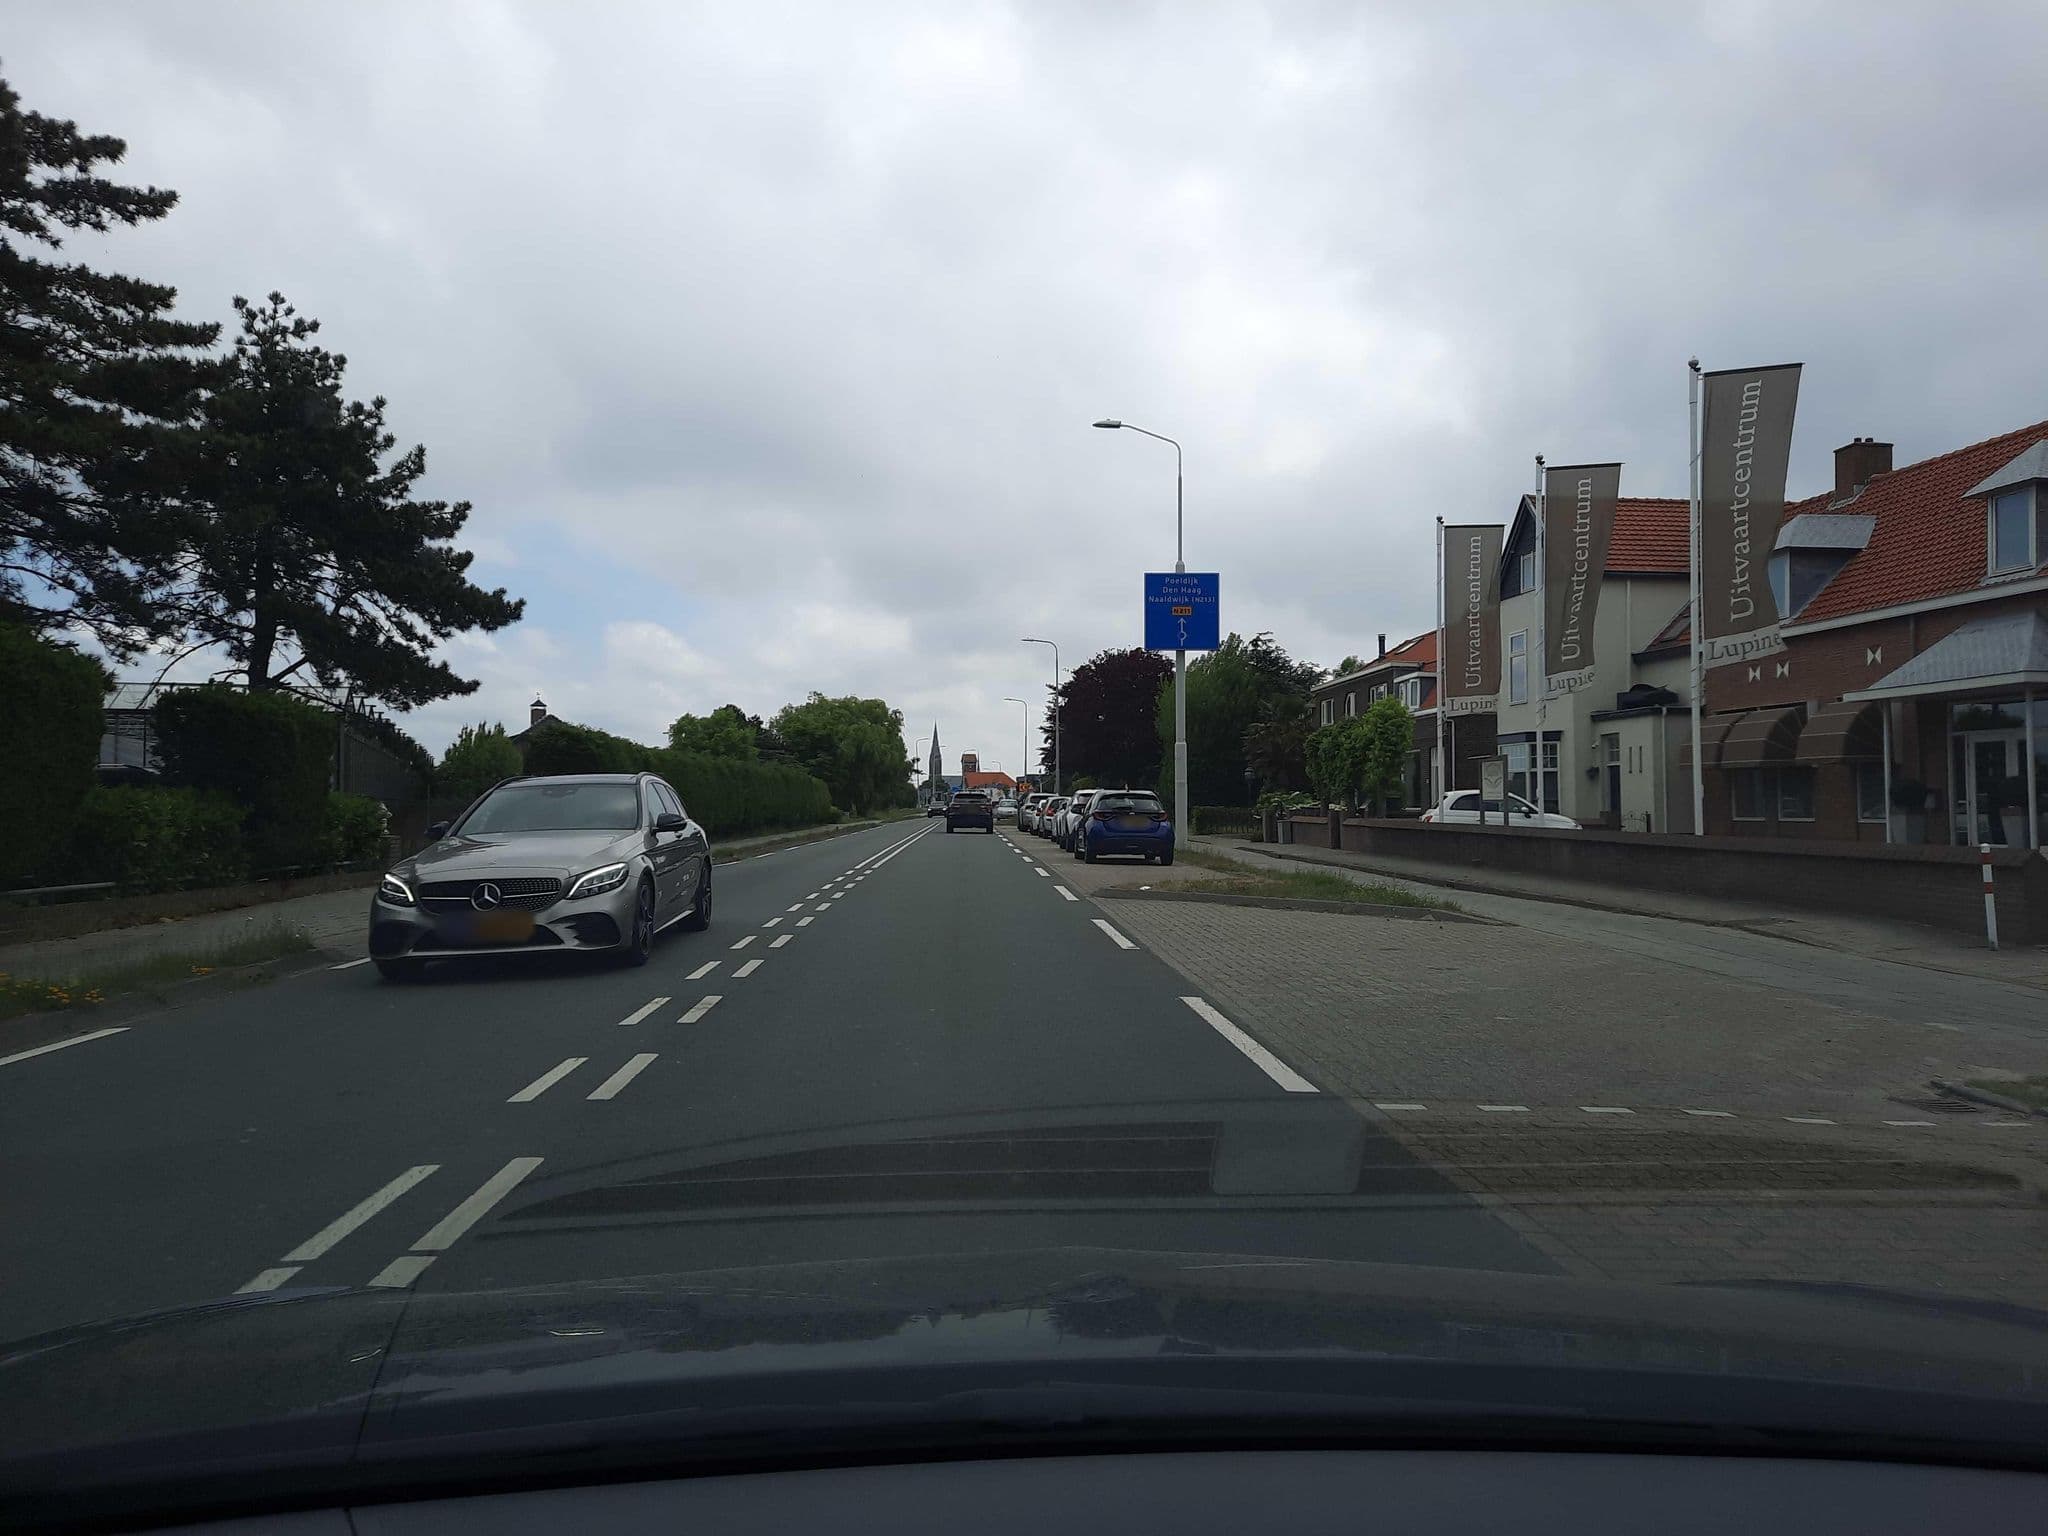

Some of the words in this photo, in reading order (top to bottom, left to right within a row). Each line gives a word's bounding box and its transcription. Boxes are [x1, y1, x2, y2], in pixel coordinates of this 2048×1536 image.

[1730, 379, 1762, 623] Uitvaartcentrum
[1165, 576, 1199, 585] Poeldijk
[1561, 476, 1592, 663] Uitvaartcentrum
[1148, 595, 1189, 604] Naaldwijk
[1162, 586, 1178, 594] Den
[1181, 586, 1202, 595] Haag
[1465, 534, 1482, 689] Uitvaartcentrum
[1706, 633, 1781, 660] Lupine
